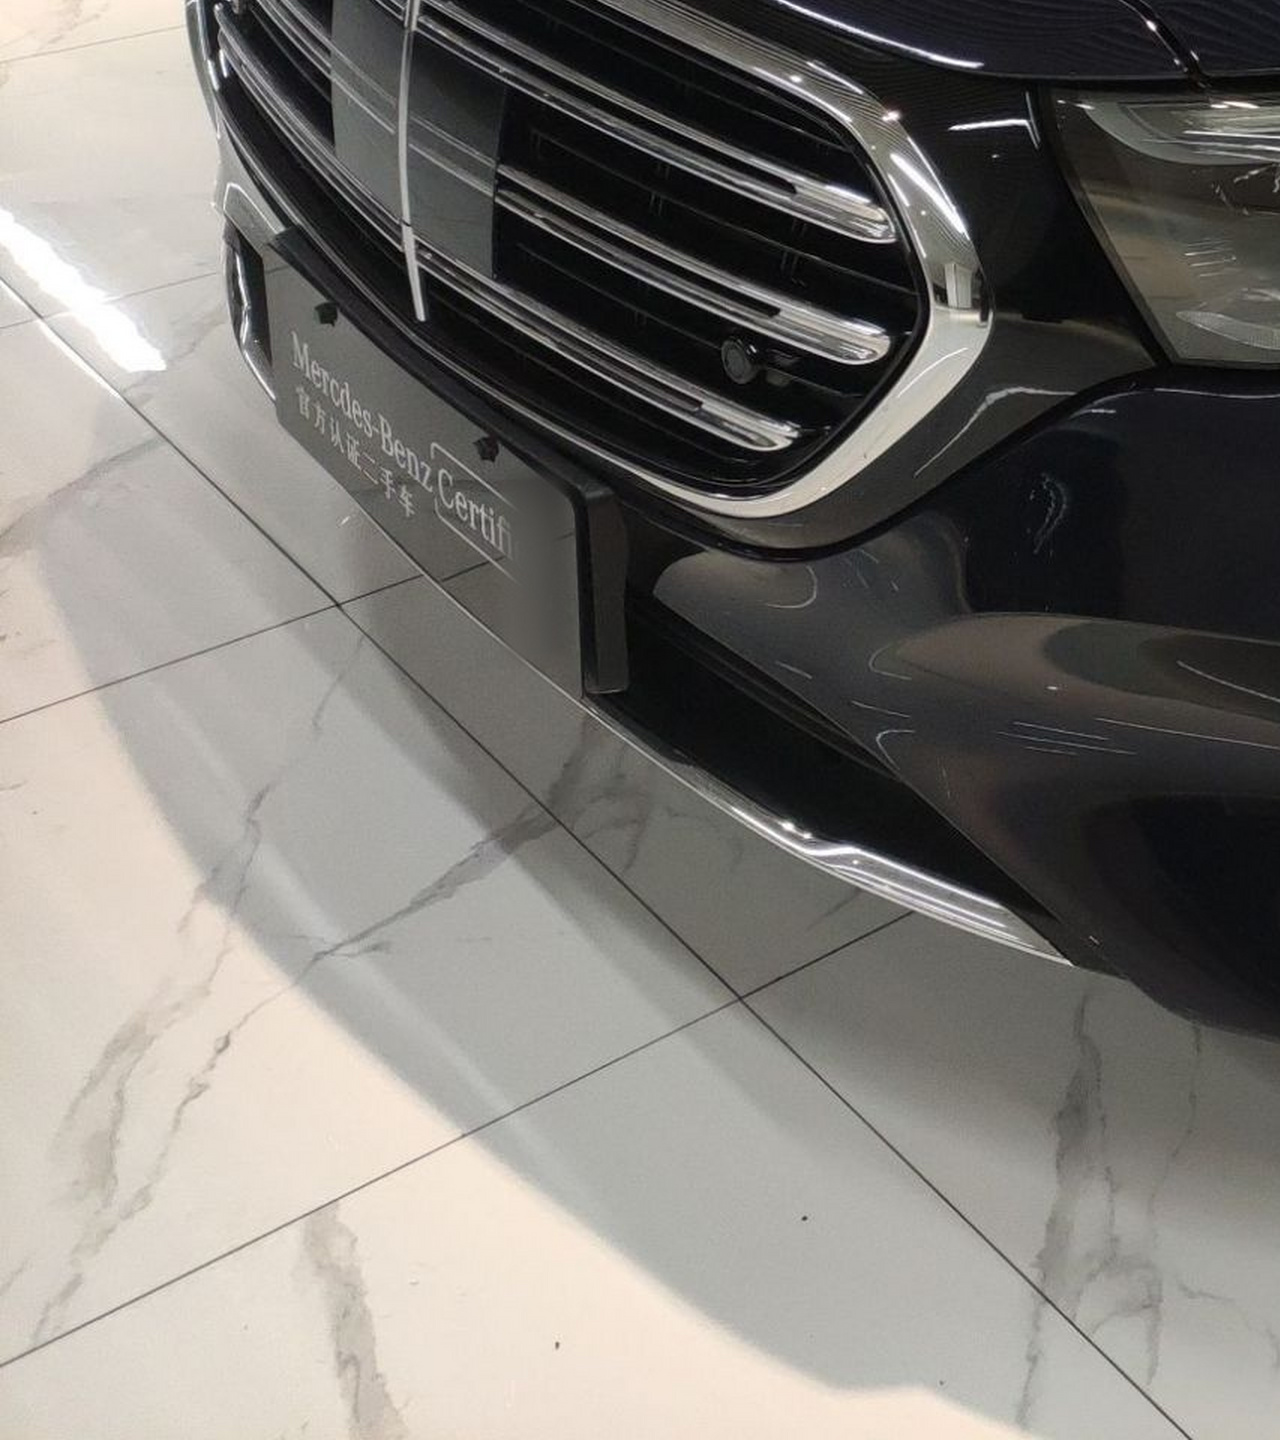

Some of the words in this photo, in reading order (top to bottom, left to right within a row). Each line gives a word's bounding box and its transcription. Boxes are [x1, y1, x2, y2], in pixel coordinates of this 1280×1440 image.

[296, 386, 416, 518] 官方认证二手车
